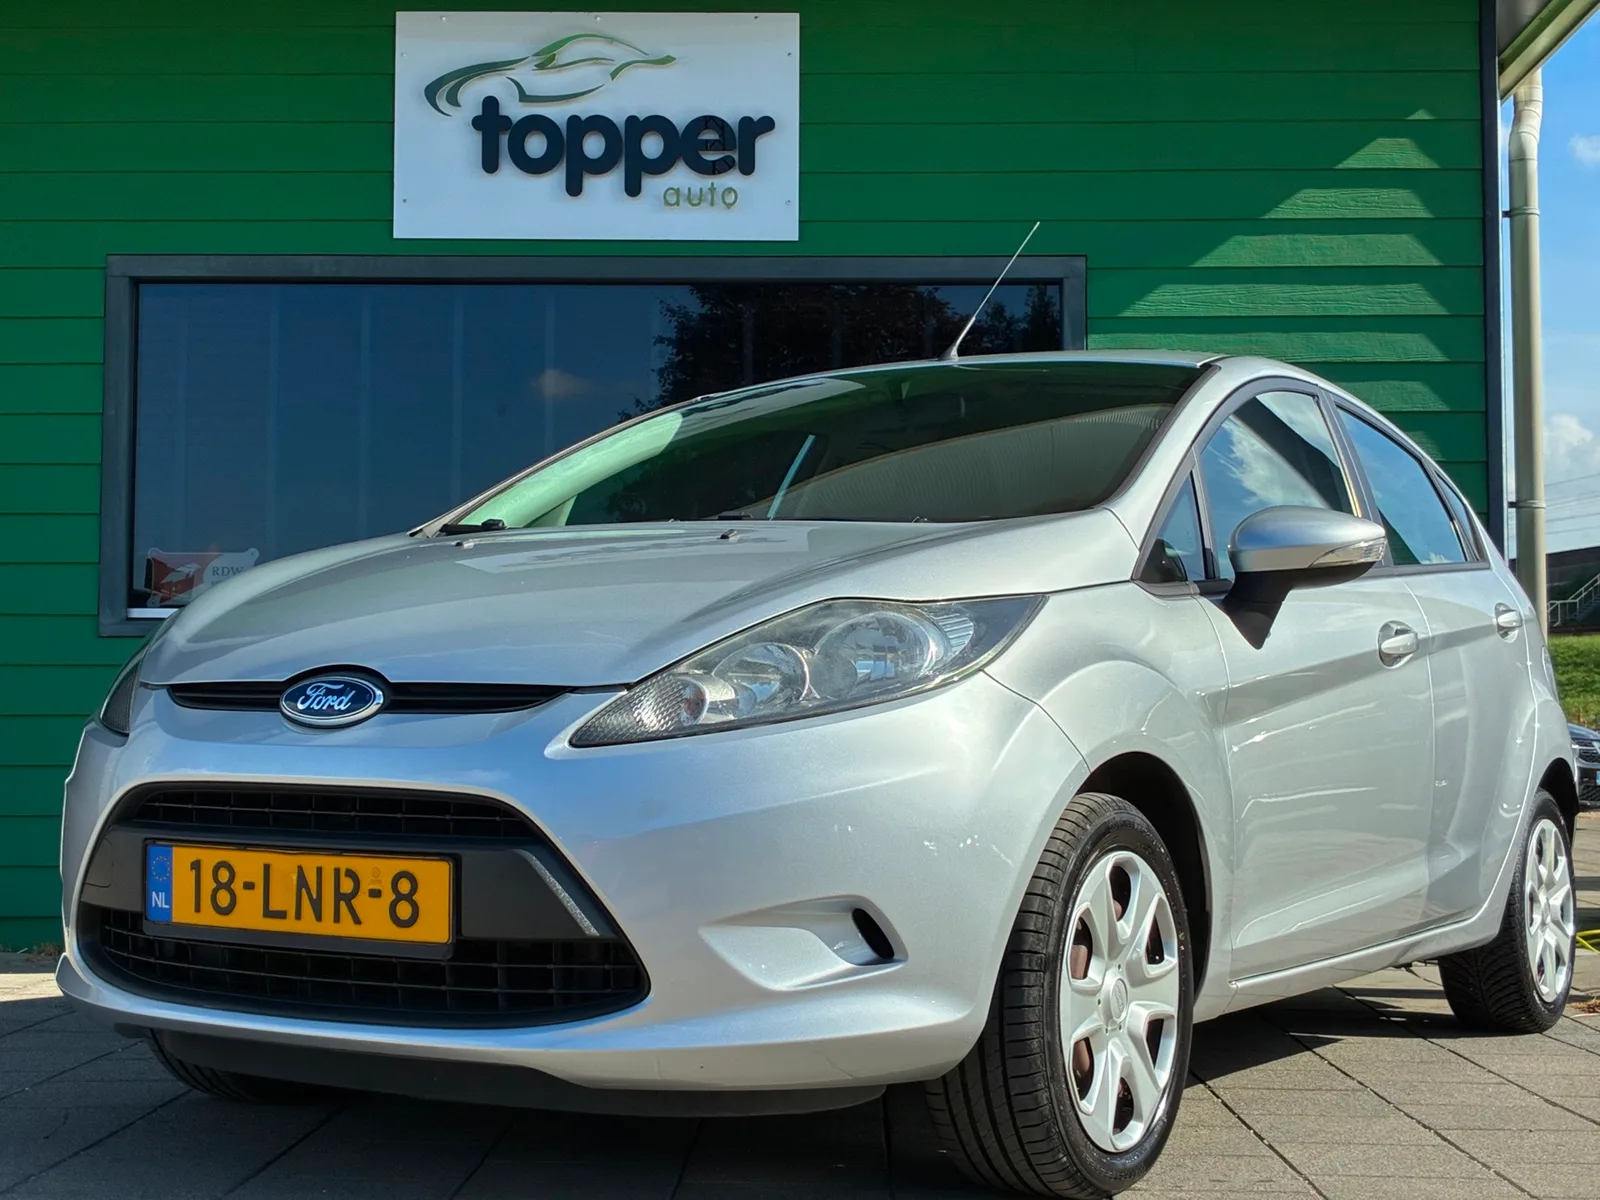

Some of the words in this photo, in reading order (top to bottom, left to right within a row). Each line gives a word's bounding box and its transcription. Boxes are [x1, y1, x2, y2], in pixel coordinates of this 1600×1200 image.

[471, 95, 776, 198] topper
[662, 181, 739, 209] auto
[297, 682, 357, 711] Ford
[151, 891, 171, 909] NL
[190, 859, 420, 929] 18-LNR-8
